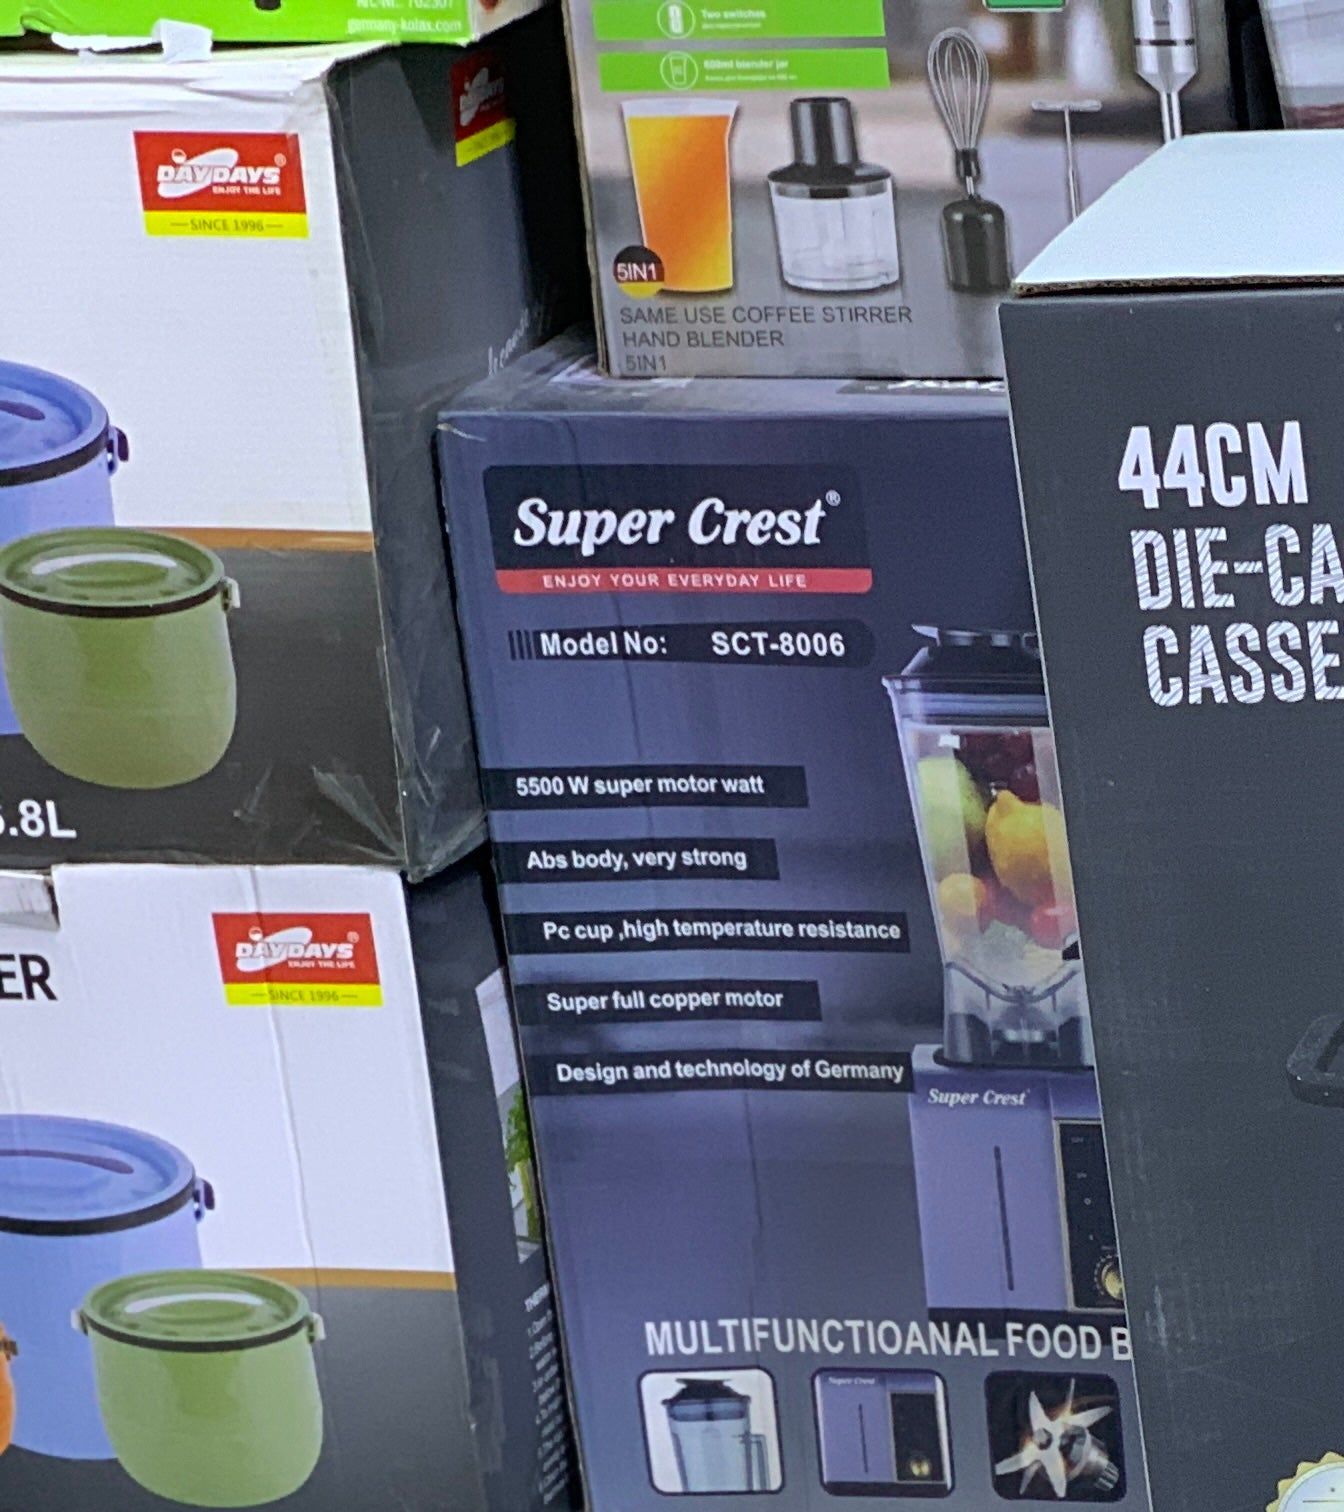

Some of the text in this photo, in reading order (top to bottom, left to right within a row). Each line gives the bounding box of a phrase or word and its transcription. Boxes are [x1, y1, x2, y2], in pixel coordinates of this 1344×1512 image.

[190, 219, 265, 232] SINCE 1996
[616, 262, 657, 282] 5IN1
[620, 306, 913, 325] SAME USE COFFEE STIRRER
[623, 330, 784, 348] HAND BLENDER
[625, 354, 668, 372] 5IN1
[1118, 420, 1309, 508] 44CM
[514, 497, 826, 556] Super Crest
[543, 574, 806, 589] ENJOY YOUR EVERYDAY LIFE
[540, 631, 845, 657] Model No: SCT-8006
[516, 775, 765, 798] 5500 W super motor watt
[0, 799, 77, 838] .8L
[527, 848, 748, 873] Abs body, very strong
[543, 921, 570, 940] Pc
[574, 925, 613, 943] cup
[673, 919, 794, 941] temperature
[798, 919, 900, 940] resistance
[269, 989, 339, 1002] SINCE 1996
[547, 990, 783, 1015] Super full copper motor
[556, 1059, 903, 1086] Design and technology of Germany
[928, 1088, 1027, 1108] Super Crest
[645, 1319, 1001, 1357] MULTIFUNCTIOANAL
[1006, 1323, 1102, 1359] FOOD
